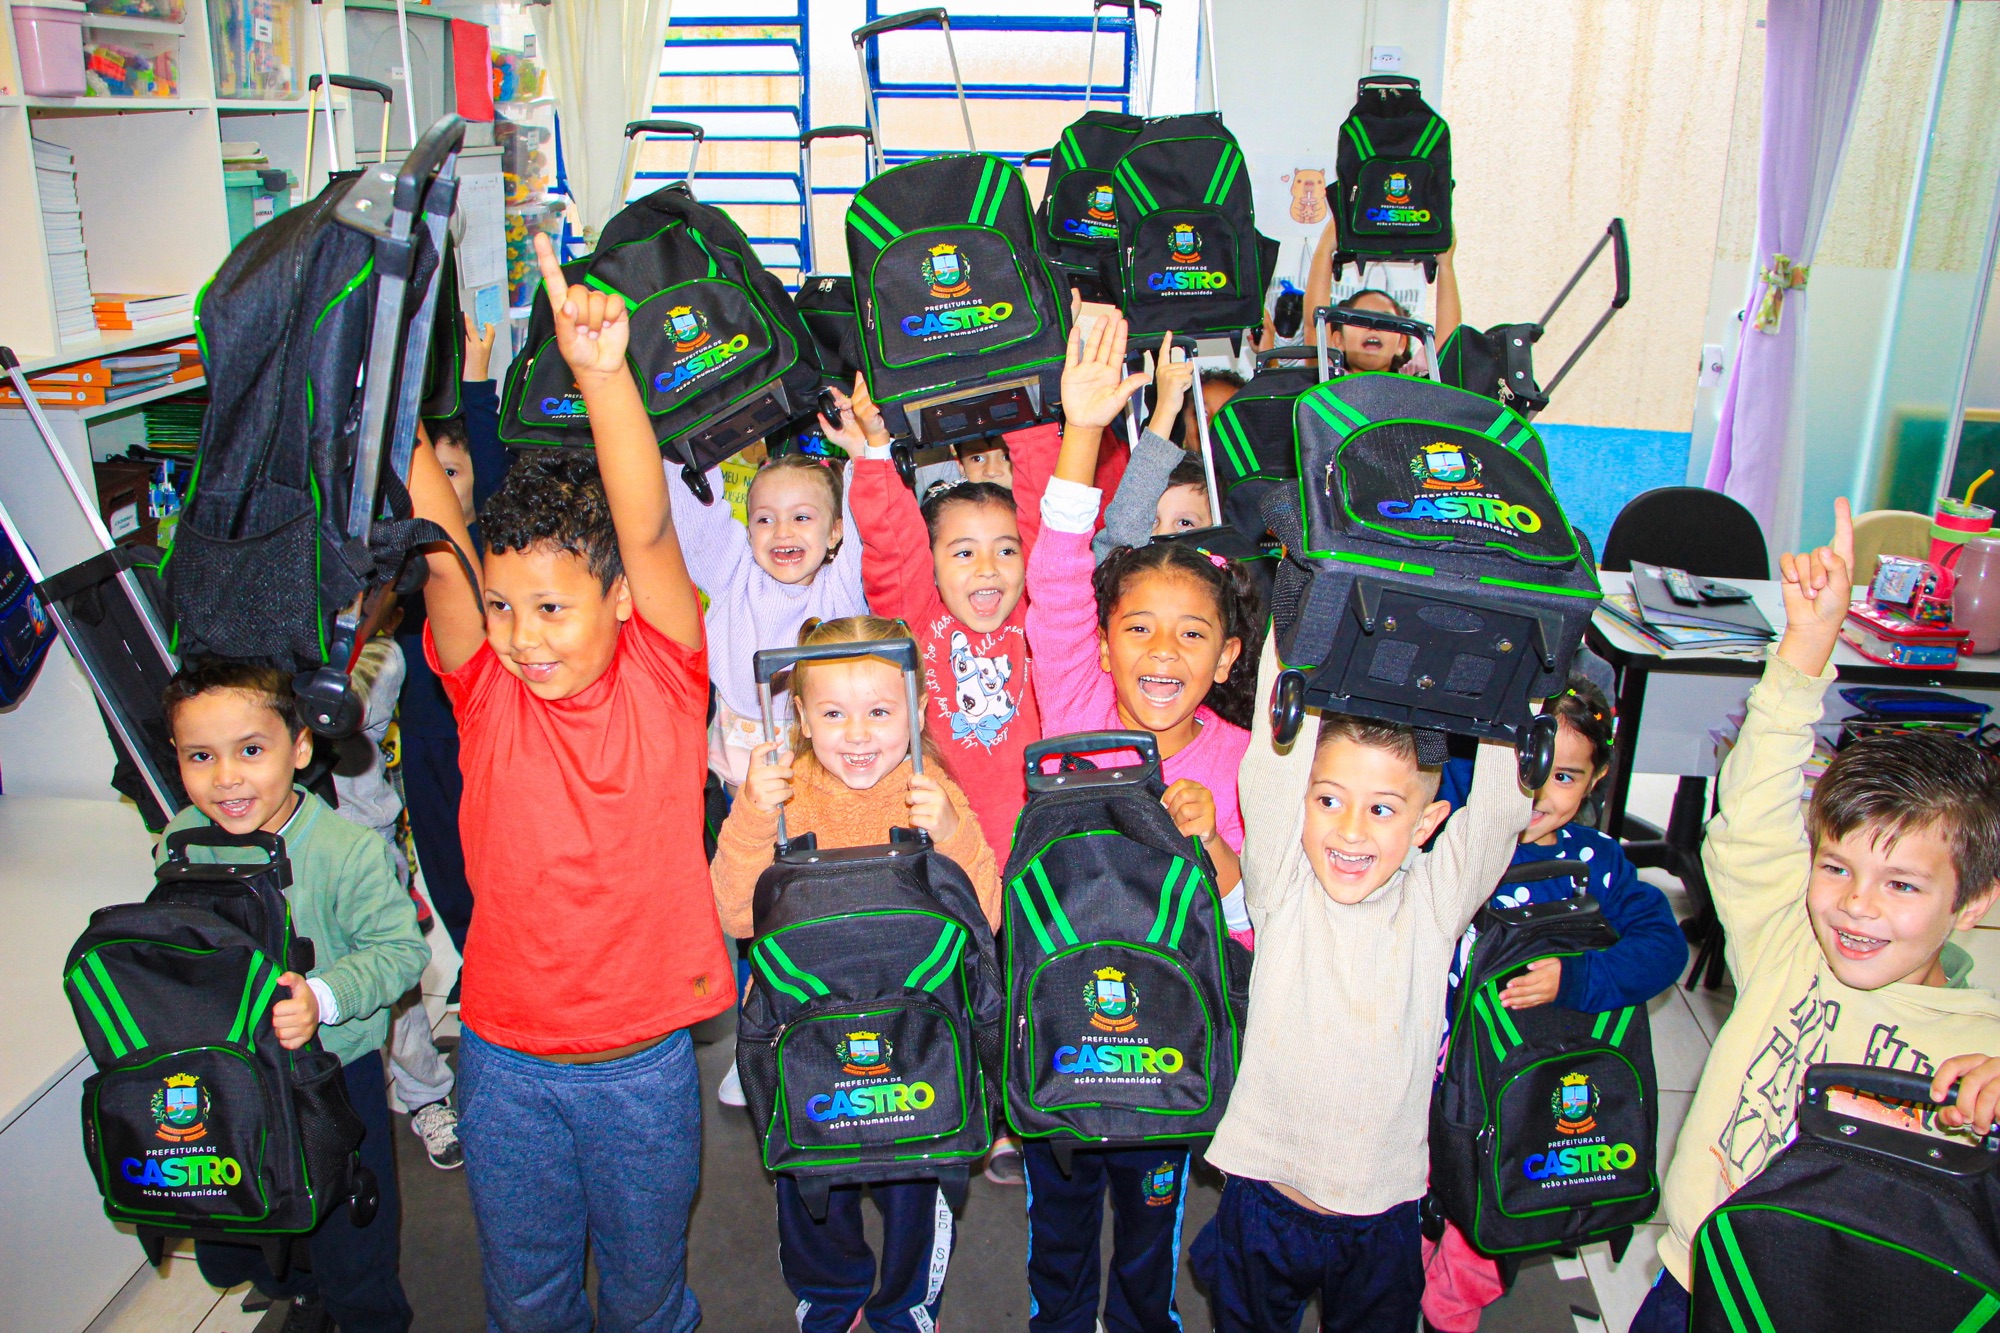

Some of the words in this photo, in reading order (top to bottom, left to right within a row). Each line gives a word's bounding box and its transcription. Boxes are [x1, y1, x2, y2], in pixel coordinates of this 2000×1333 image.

[1366, 207, 1431, 223] CASTRO
[1064, 219, 1119, 239] CASTR
[1147, 271, 1227, 290] CASTRO
[925, 300, 971, 311] PREFEITURA
[900, 302, 1014, 337] CASTRO
[950, 324, 999, 336] humanidade
[673, 345, 712, 366] PREFEITURA
[713, 339, 723, 347] DE
[654, 334, 749, 393] CASTRO
[541, 397, 589, 415] CAS
[1414, 491, 1483, 500] PREFEITURA
[1377, 496, 1542, 534] CASTRO
[1082, 1036, 1135, 1044] PREFEITURA
[1052, 1044, 1184, 1074] CASTRO
[834, 1078, 888, 1089] PREFEITURA
[1074, 1076, 1096, 1084] ação
[1106, 1076, 1162, 1084] humanidade
[805, 1081, 935, 1123] CASTRO
[829, 1120, 851, 1129] ação
[860, 1114, 915, 1126] humanidade
[1548, 1137, 1594, 1149] PREFEITURA
[146, 1147, 204, 1156] PREFEITURA
[1522, 1142, 1637, 1180] CASTRO
[121, 1156, 241, 1188] CASTRO
[1541, 1180, 1561, 1189] ação
[1569, 1174, 1617, 1185] humanidade
[143, 1188, 162, 1197] ação
[171, 1188, 227, 1197] humanidade
